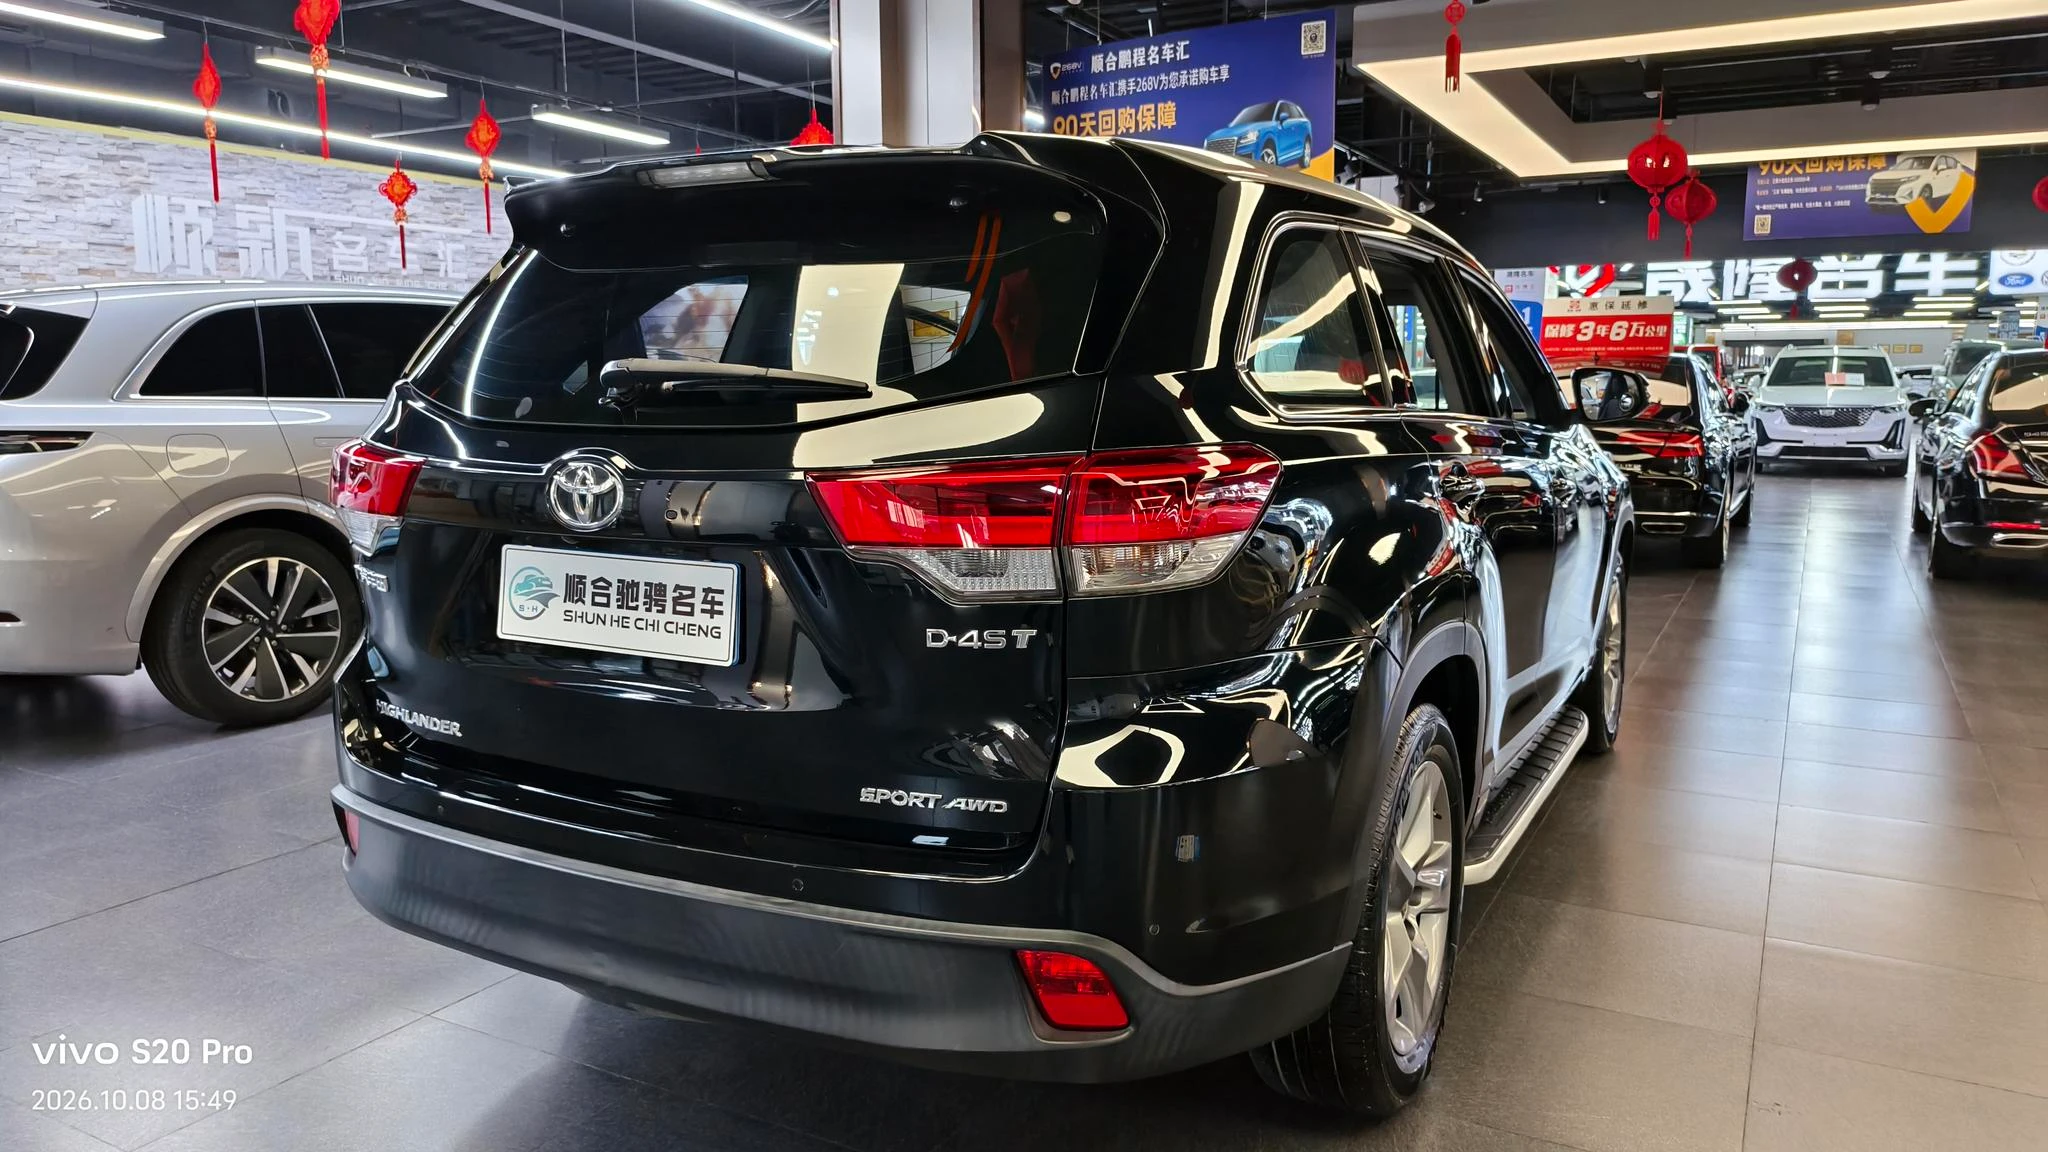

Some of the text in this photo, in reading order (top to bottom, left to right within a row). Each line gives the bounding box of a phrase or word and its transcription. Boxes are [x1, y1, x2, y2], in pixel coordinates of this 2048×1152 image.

[1091, 40, 1190, 74] 顺合鹏程名车汇
[1053, 101, 1177, 136] 90天回购保障
[1544, 321, 1668, 341] 保修3年6万公里
[563, 573, 725, 619] 顺合驰骋名车
[563, 610, 722, 639] SHUN HE CHI CHENG
[376, 699, 463, 737] HIGHLANDER
[859, 787, 1008, 813] SPORT AWD
